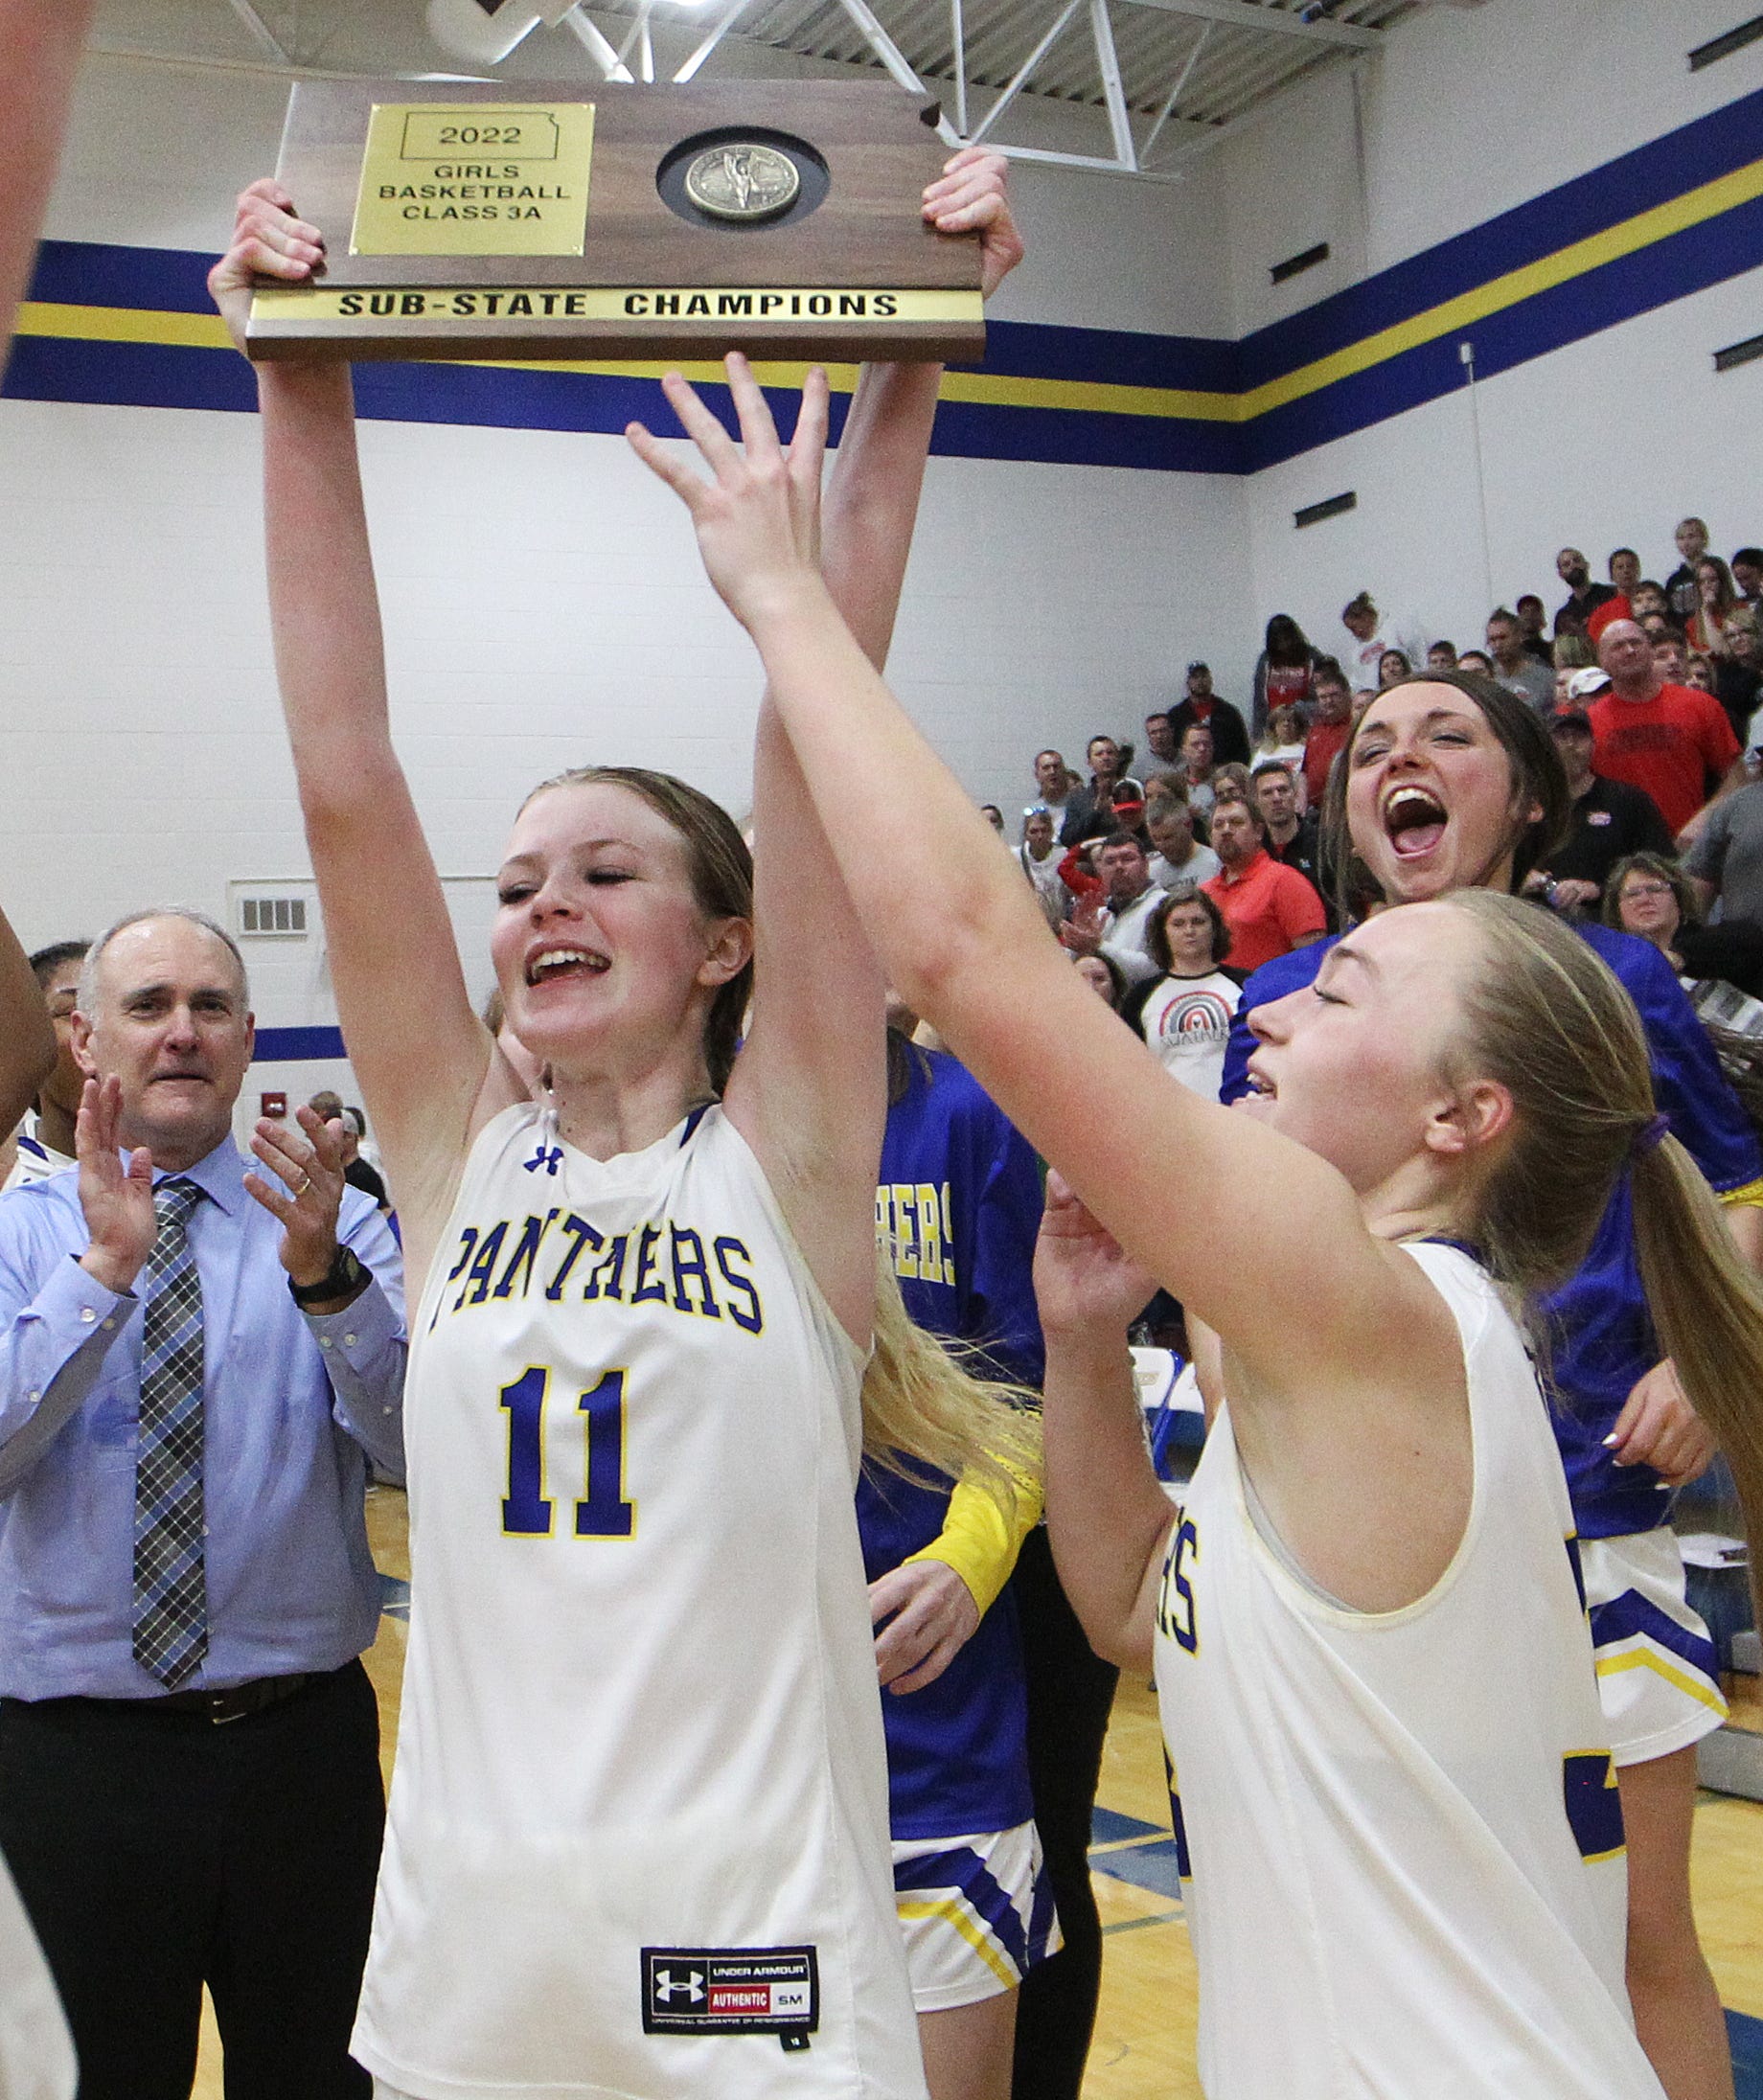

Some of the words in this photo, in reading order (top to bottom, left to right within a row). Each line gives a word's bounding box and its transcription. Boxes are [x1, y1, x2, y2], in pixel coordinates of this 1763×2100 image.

[439, 126, 521, 144] 2022
[434, 165, 520, 178] GIRLS
[378, 185, 572, 198] BASKETBALL
[402, 205, 498, 219] CLASS
[507, 206, 542, 219] 3A
[338, 292, 586, 316] SUB-STATE
[624, 293, 898, 316] CHAMPIONS
[497, 1363, 636, 1541] 11
[712, 1967, 751, 1977] UNDER
[752, 1965, 804, 1976] ARMOUR
[712, 1993, 767, 2007] AUTHENTIC
[778, 1995, 803, 2006] SM
